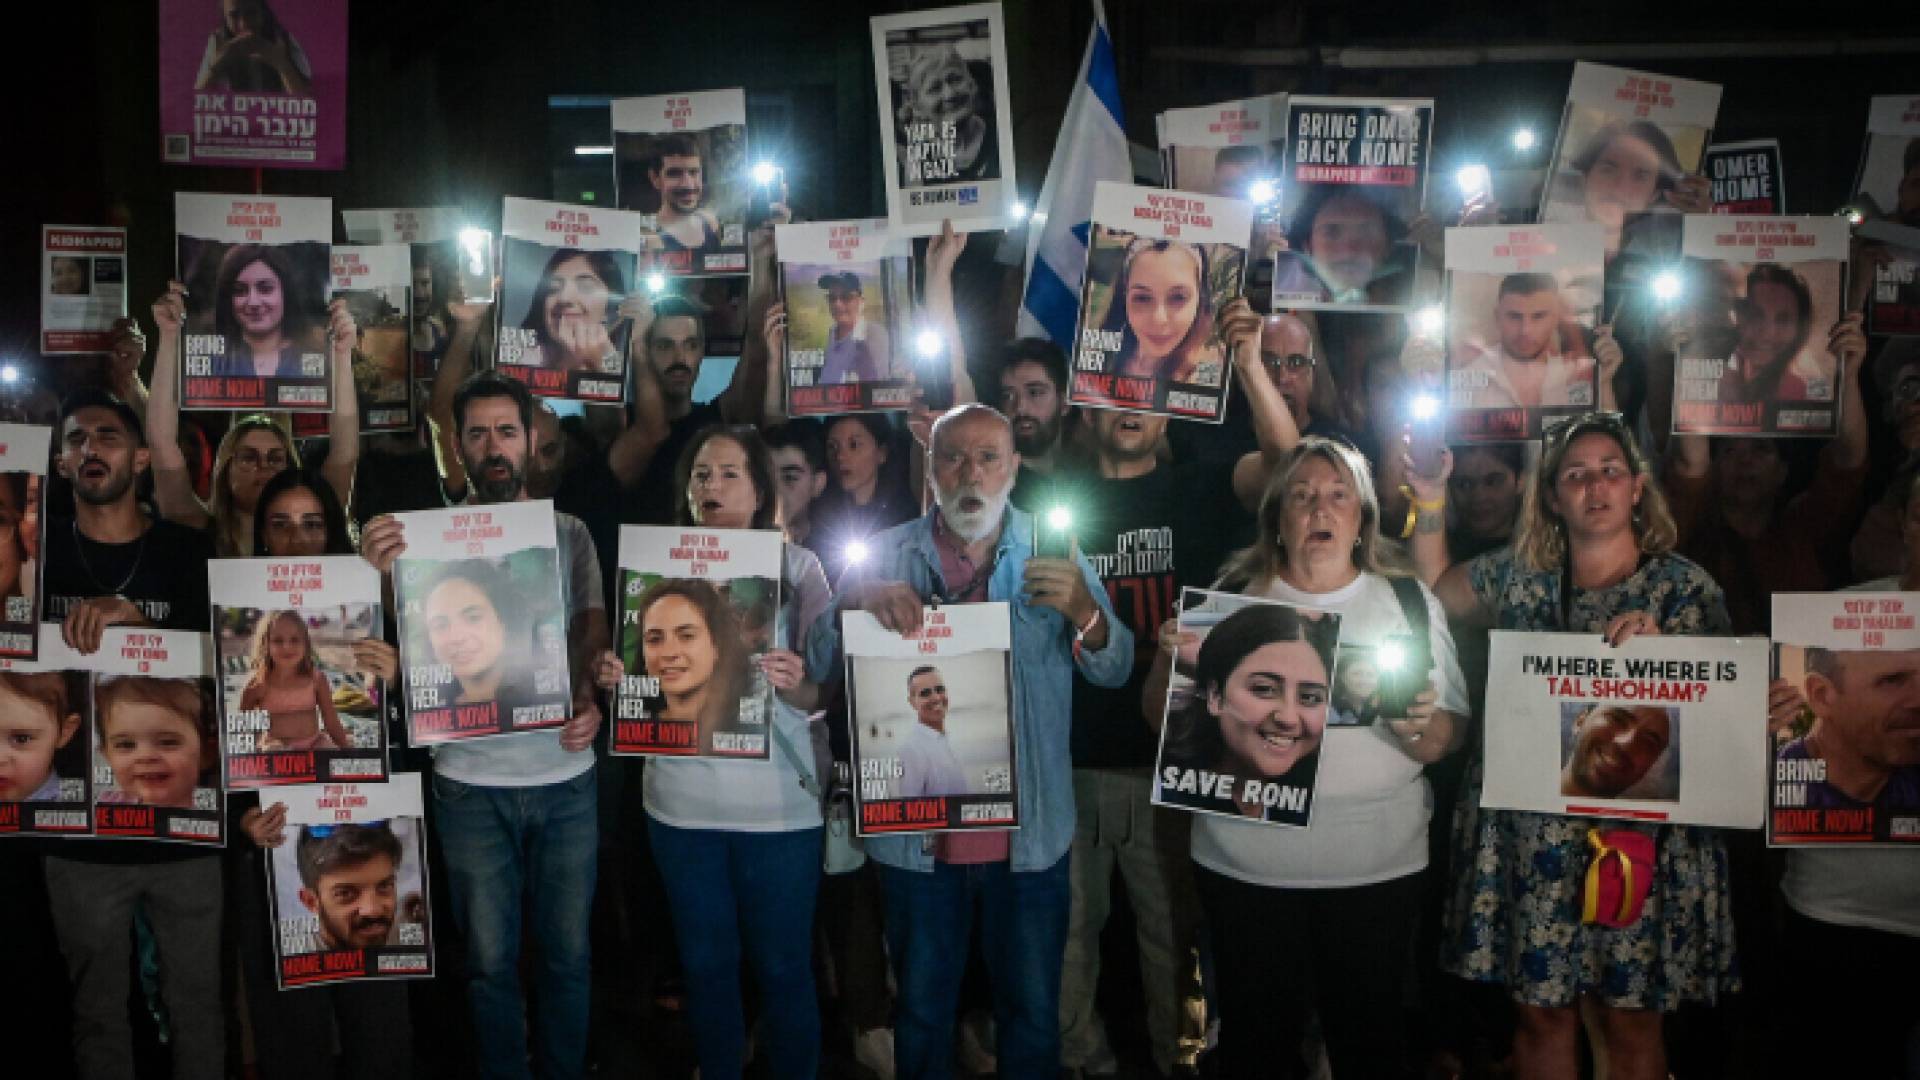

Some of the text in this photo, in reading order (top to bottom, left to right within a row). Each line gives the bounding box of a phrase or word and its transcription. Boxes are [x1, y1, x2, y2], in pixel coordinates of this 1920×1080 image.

[195, 94, 317, 114] מחזירים את
[195, 113, 249, 143] הימן
[256, 117, 316, 138] ענבר
[1299, 113, 1420, 139] BRING OMER
[1296, 139, 1419, 165] BACK HOME
[1714, 153, 1770, 178] OMER
[1714, 175, 1772, 203] HOME
[186, 334, 225, 355] BRING
[1080, 329, 1123, 352] BRING
[186, 355, 212, 376] HER
[186, 378, 223, 398] HOME
[226, 377, 265, 398] NOW!
[410, 663, 452, 687] BRING
[1522, 655, 1553, 676] I'M
[1624, 658, 1710, 681] WHERE
[1715, 660, 1738, 681] IS
[617, 674, 660, 698] BRING
[1547, 677, 1708, 703] TAL SHOHAM?
[227, 709, 271, 733] BRING
[414, 709, 454, 733] HOME
[457, 700, 498, 729] NOW!
[227, 732, 255, 754] HER
[617, 720, 655, 744] HOME
[658, 720, 698, 745] NOW!
[229, 754, 271, 778] HOME
[273, 750, 316, 775] NOW!
[861, 757, 904, 779] BRING
[1776, 758, 1827, 784] BRING
[1161, 765, 1308, 814] SAVE RONI
[1776, 783, 1808, 807] HIM
[113, 806, 155, 829] NOW!
[863, 801, 903, 823] HOME
[906, 796, 947, 822] NOW!
[1774, 809, 1820, 833] HOME
[1824, 807, 1874, 834] NOW!
[283, 954, 321, 978] HOME
[323, 949, 365, 973] NOW!
